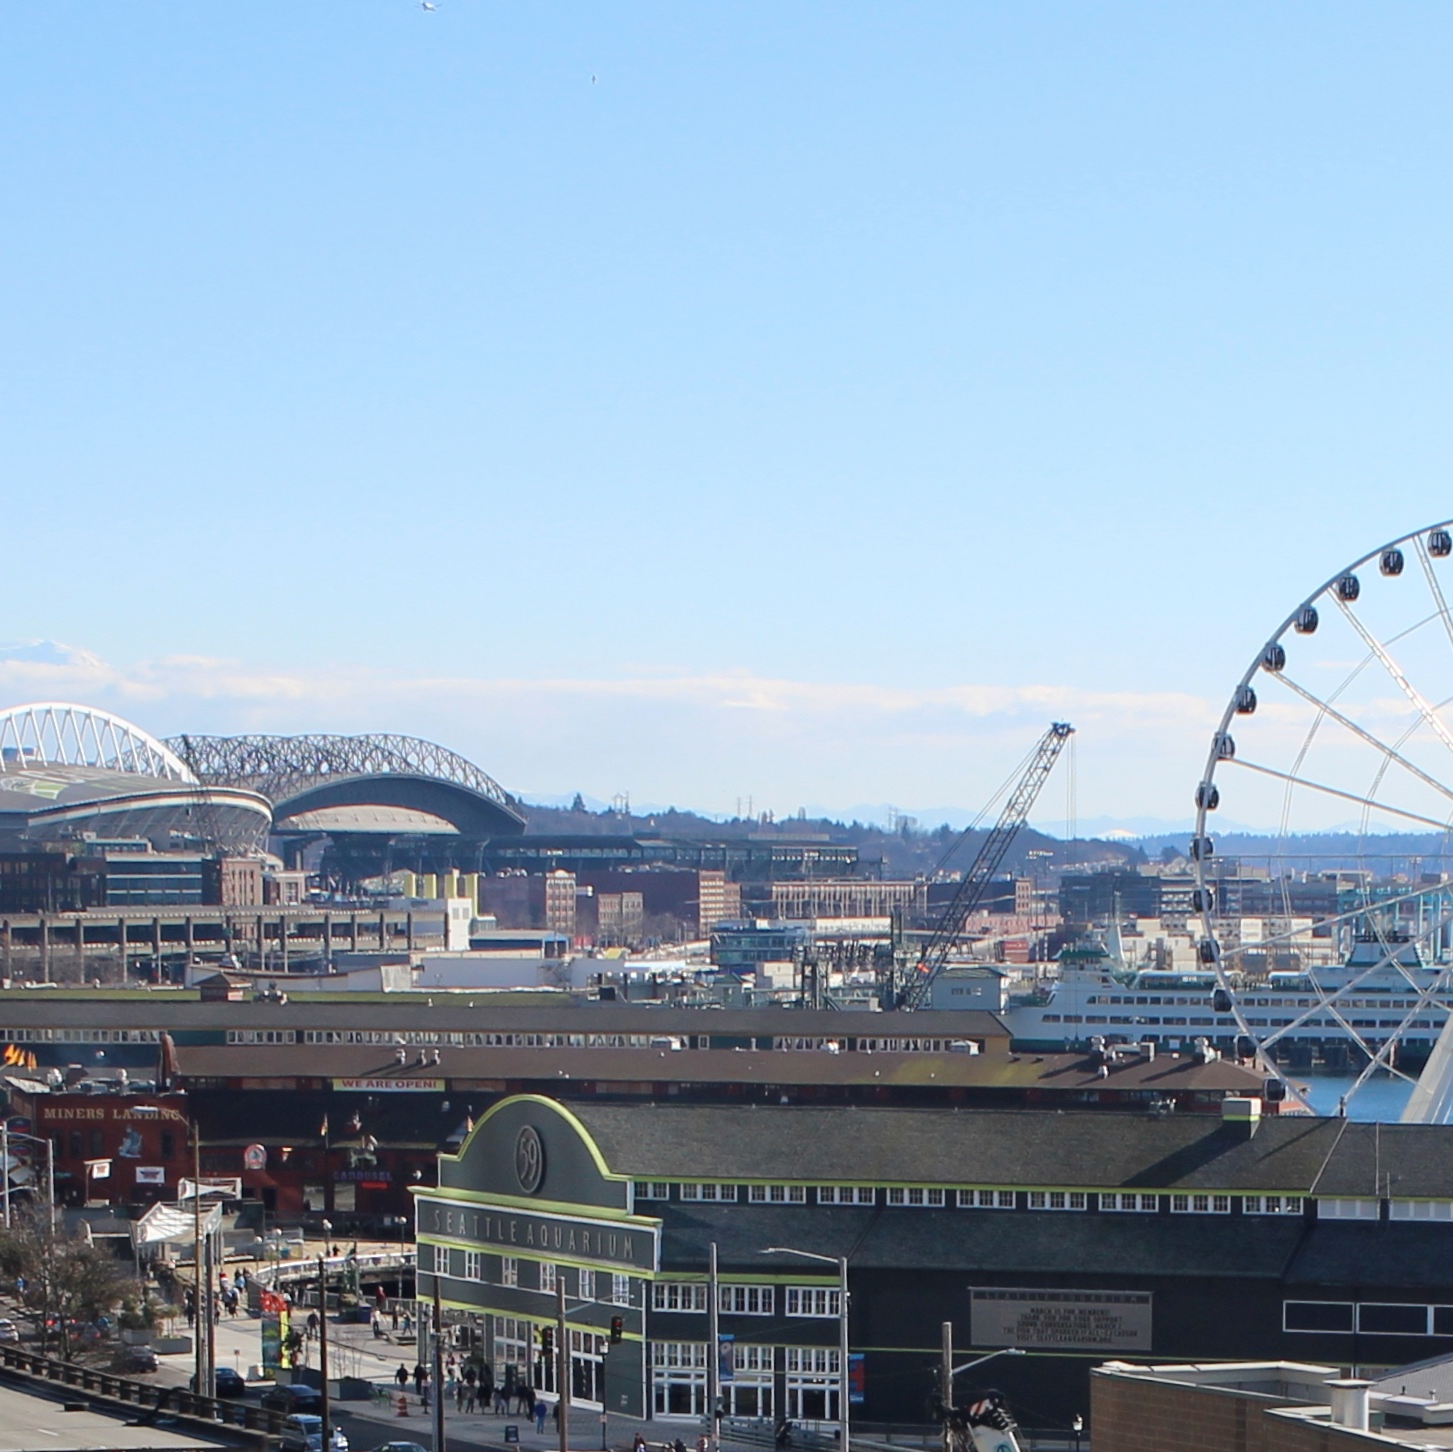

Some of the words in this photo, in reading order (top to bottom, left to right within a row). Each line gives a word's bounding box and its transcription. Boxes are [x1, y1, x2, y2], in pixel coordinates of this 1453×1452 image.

[342, 1079, 364, 1088] WE
[366, 1079, 392, 1088] ARE
[395, 1079, 437, 1089] OPEN!
[44, 1107, 105, 1119] MINERS
[112, 1108, 180, 1121] LANDING
[520, 1138, 537, 1182] 59
[333, 1171, 393, 1181] CAROUSEL
[433, 1210, 518, 1242] SEATTLE
[526, 1223, 634, 1259] AQUARIUM
